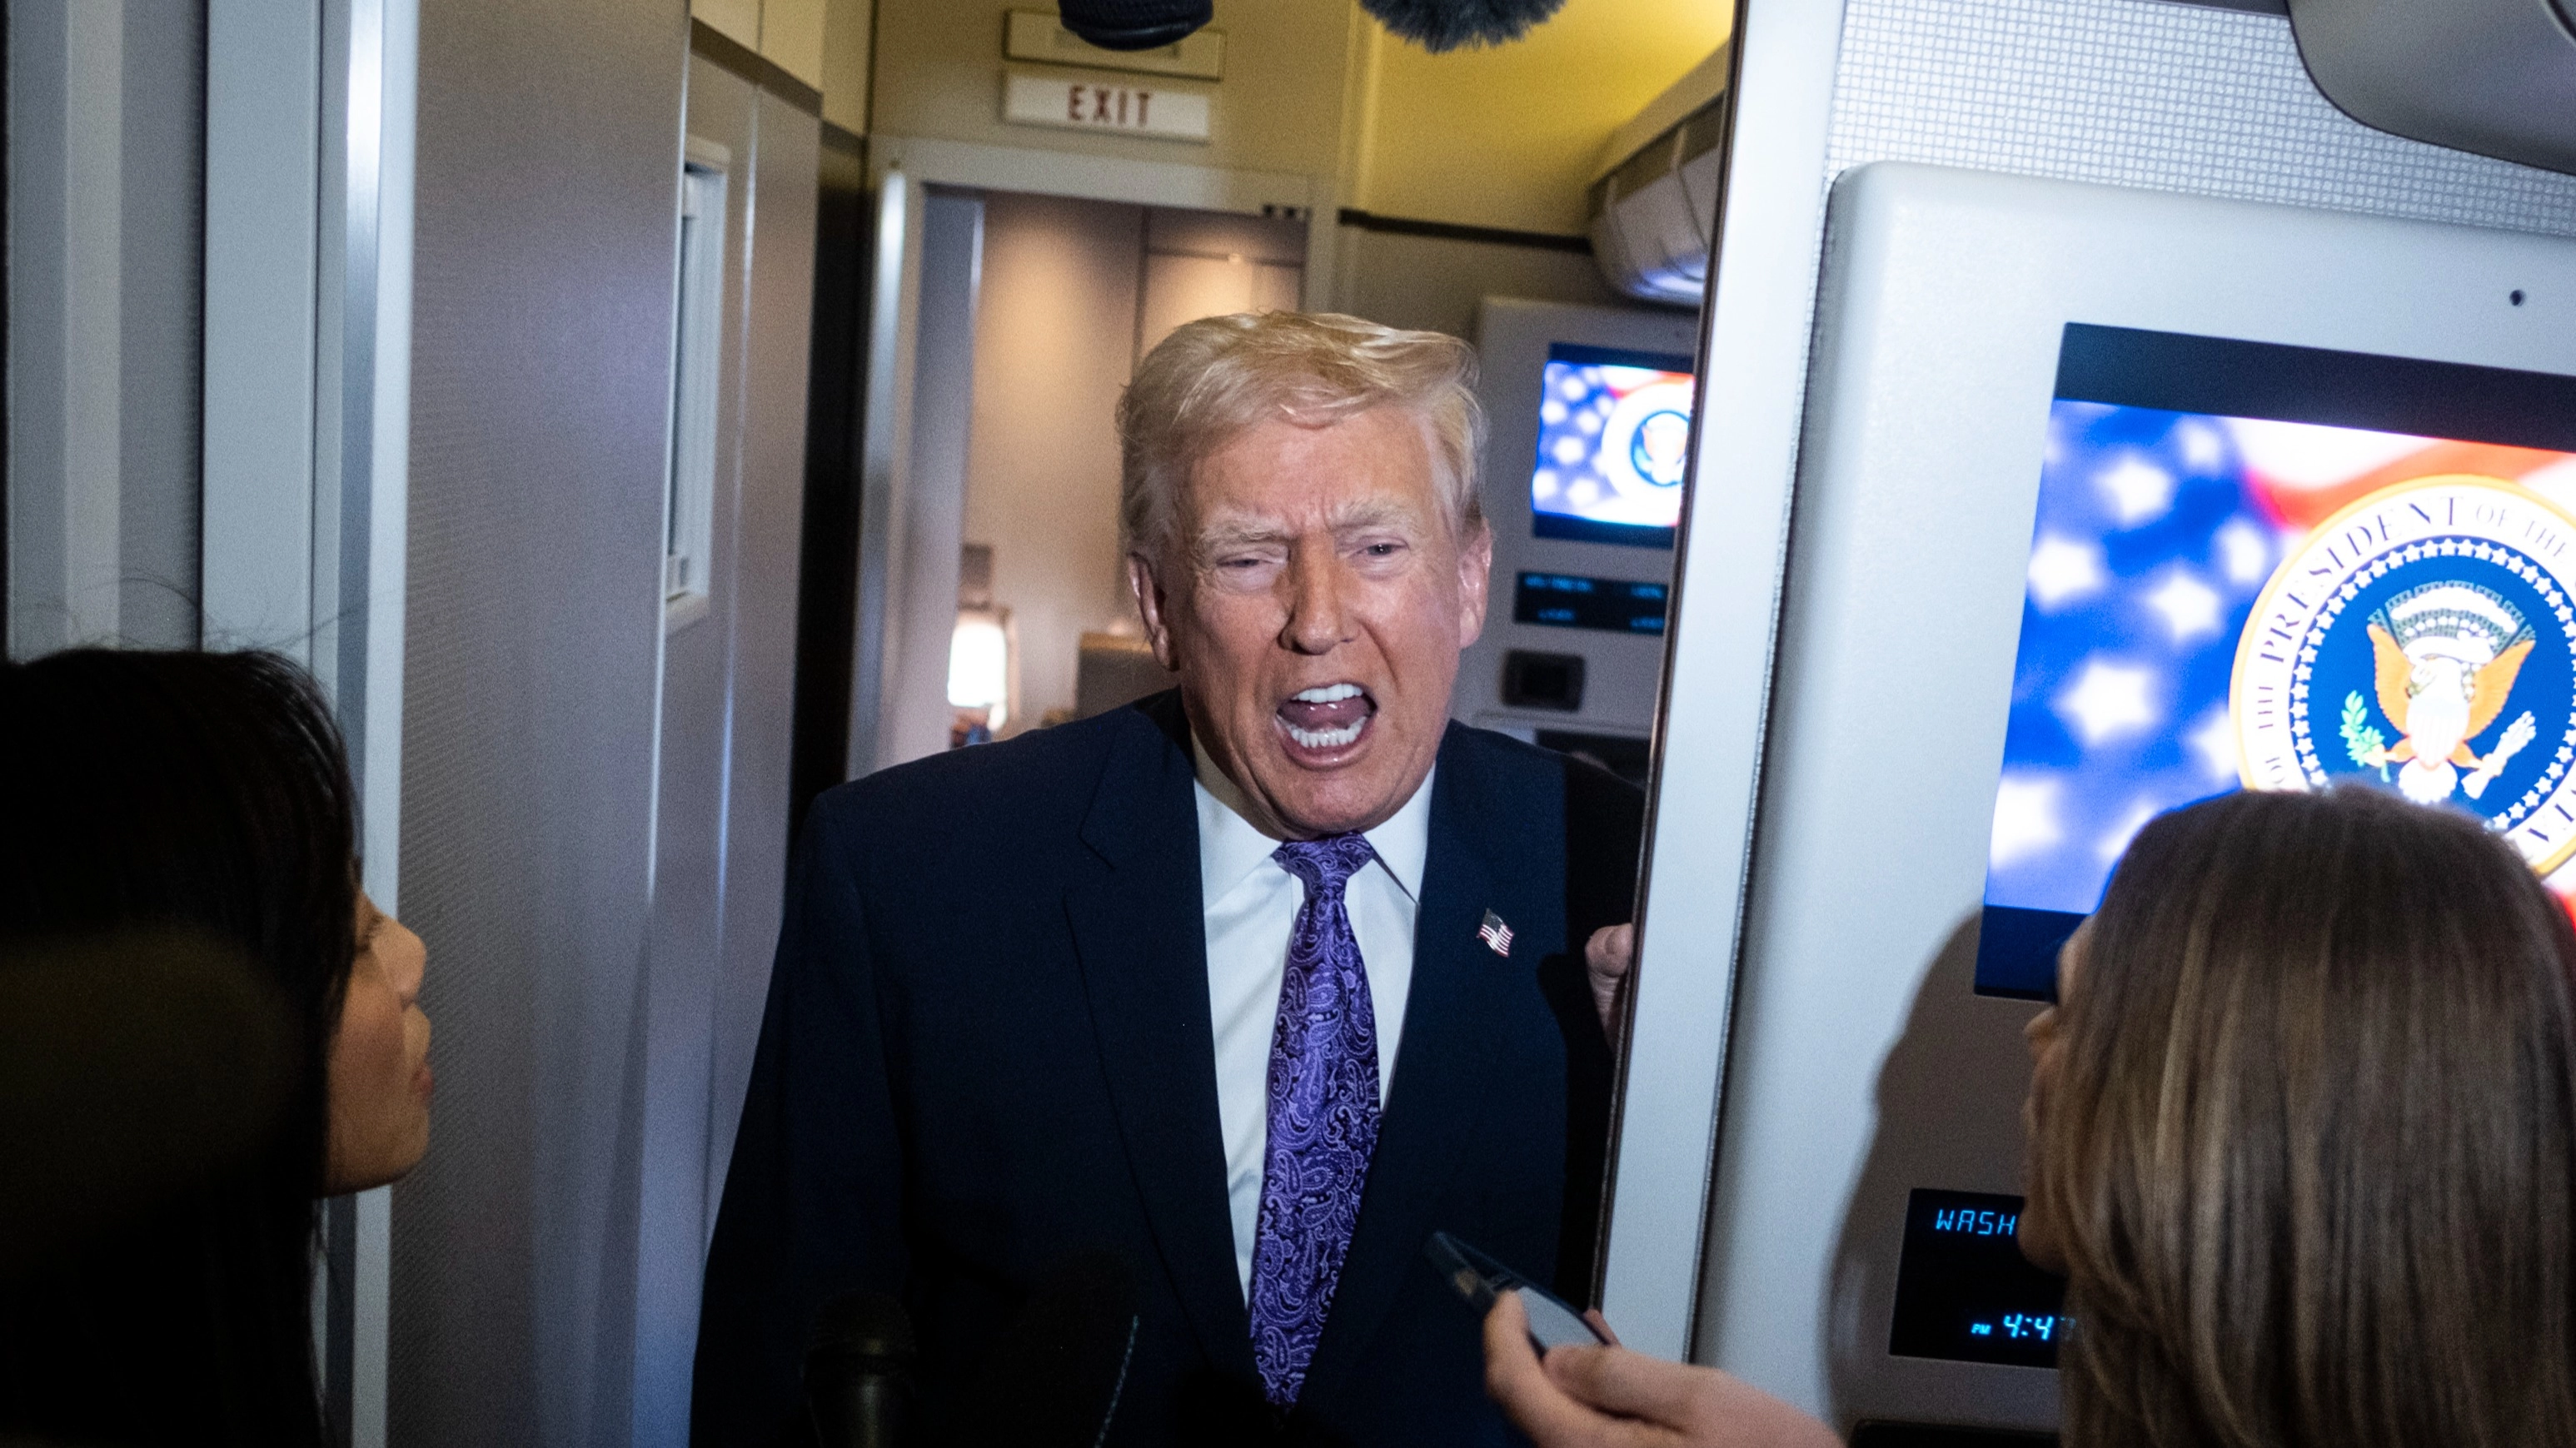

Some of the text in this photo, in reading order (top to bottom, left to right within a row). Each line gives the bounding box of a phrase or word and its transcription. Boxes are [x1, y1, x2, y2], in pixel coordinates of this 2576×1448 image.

[1067, 85, 1150, 127] EXIT
[2260, 496, 2463, 663] PRESIDENT
[2476, 503, 2509, 528] OF
[2523, 519, 2570, 560] THE
[1971, 1322, 1992, 1336] PM
